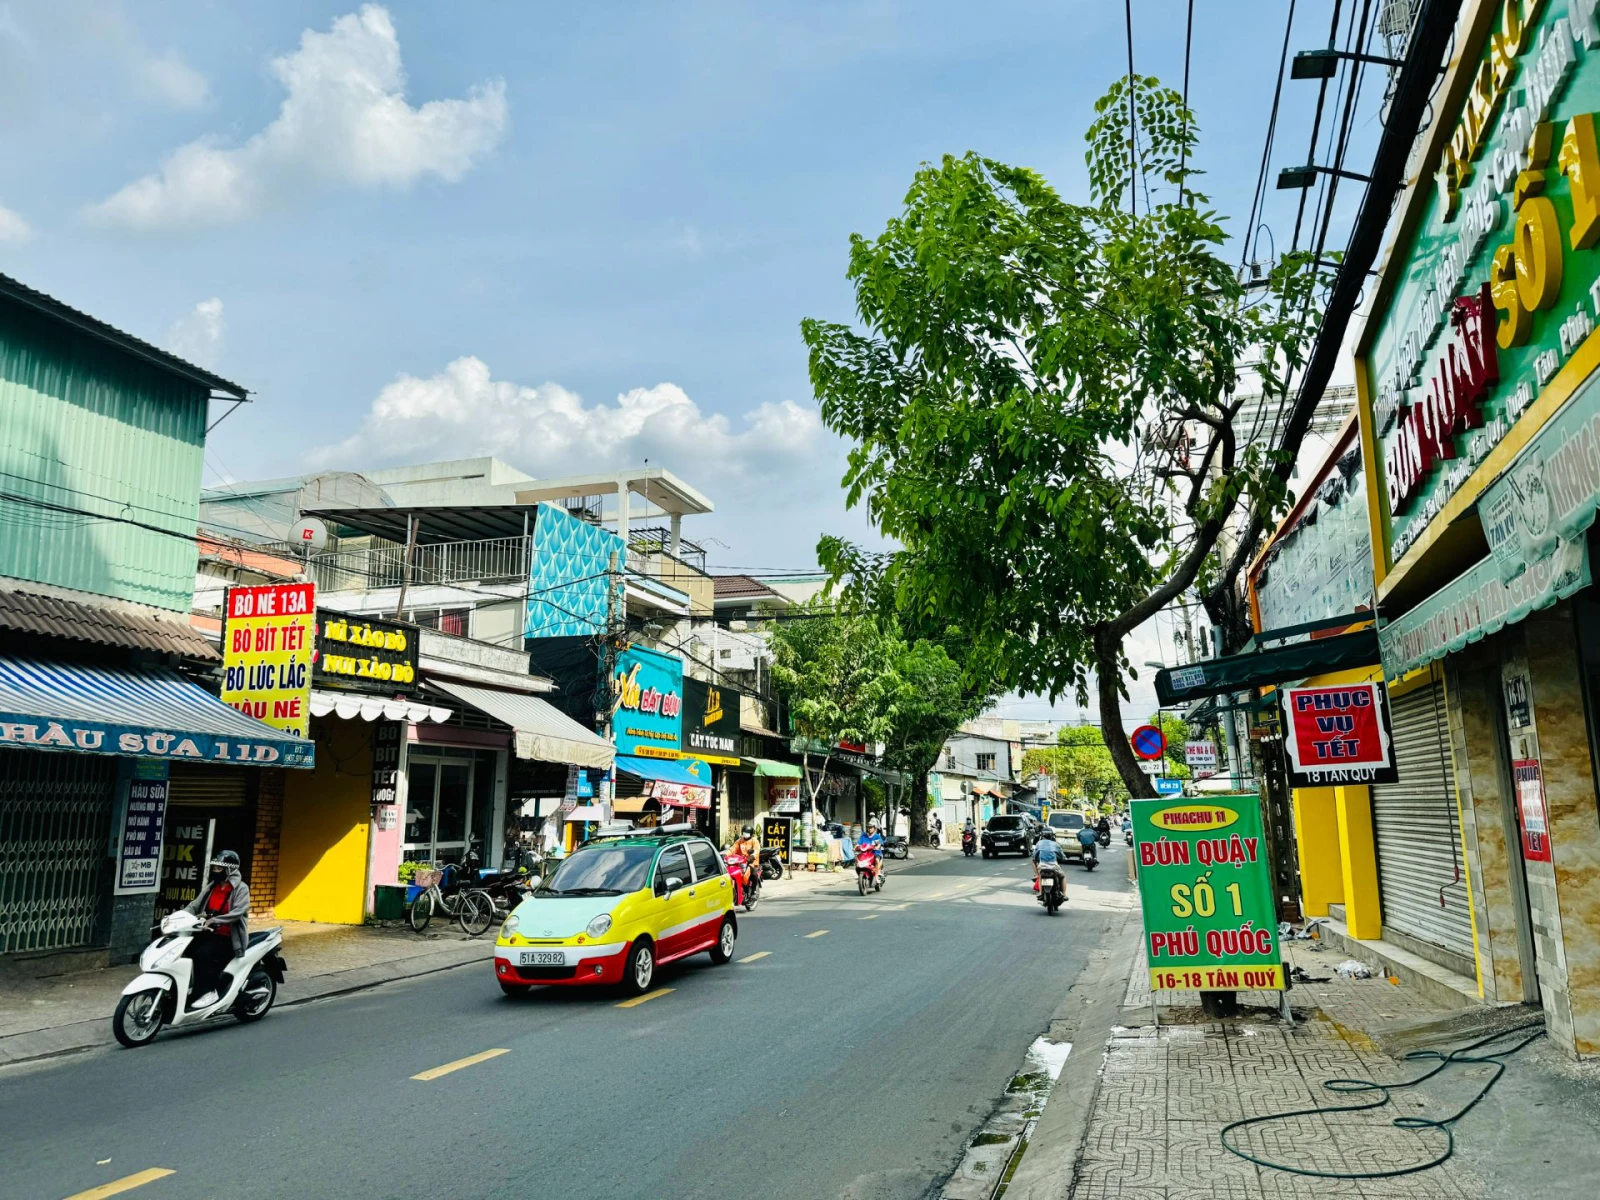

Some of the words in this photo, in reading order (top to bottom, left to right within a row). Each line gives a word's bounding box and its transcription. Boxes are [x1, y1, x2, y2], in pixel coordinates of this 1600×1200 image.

[1384, 400, 1432, 516] BÚN
[1491, 121, 1562, 349] SỐ
[1558, 113, 1600, 249] 1
[1533, 349, 1560, 387] Tân
[235, 590, 252, 616] BÒ
[258, 590, 276, 614] NÉ
[281, 591, 306, 613] 13A
[233, 623, 251, 653] BÒ
[256, 623, 278, 651] BÍT
[281, 618, 305, 650] TẾT
[325, 618, 347, 641] MÌ
[349, 623, 385, 649] XÀO
[385, 629, 407, 652] BÒ
[226, 660, 246, 691] BÒ
[249, 660, 274, 690] LÚC
[280, 654, 306, 689] LẮC
[323, 653, 356, 675] NUI
[356, 656, 391, 680] XÀO
[392, 660, 414, 683] BÒ
[274, 697, 301, 718] NÉ
[641, 686, 661, 712] BÁT
[1296, 690, 1371, 712] PHỤC
[1315, 715, 1355, 735] VỤ
[0, 721, 105, 749] HÀU
[119, 732, 202, 757] SỮA
[215, 742, 280, 763] 11D
[690, 726, 704, 748] CẮT
[704, 731, 719, 750] TÓC
[718, 737, 734, 752] NAM
[1312, 735, 1360, 758] TẾT
[376, 744, 397, 761] BÍT
[373, 765, 397, 784] TẾT
[1306, 769, 1320, 782] 18
[131, 783, 148, 798] HÀU
[150, 784, 165, 799] SỮA
[372, 788, 395, 801] 100Gr
[767, 822, 786, 835] CẮT
[1163, 811, 1212, 825] PIKACHU
[1215, 810, 1226, 823] 11
[176, 825, 204, 839] NÉ
[767, 837, 785, 848] TÓC
[1139, 836, 1190, 867] BÚN
[1196, 833, 1258, 869] QUẬY
[140, 861, 152, 869] MB
[175, 866, 198, 880] NÉ
[1170, 870, 1216, 919] SỐ
[1225, 882, 1243, 917] 1
[1150, 925, 1200, 957] PHÚ
[1206, 920, 1272, 957] QUỐC
[1156, 972, 1202, 989] 16-18
[1206, 968, 1239, 988] TÂN
[1244, 967, 1275, 989] QUÝ
